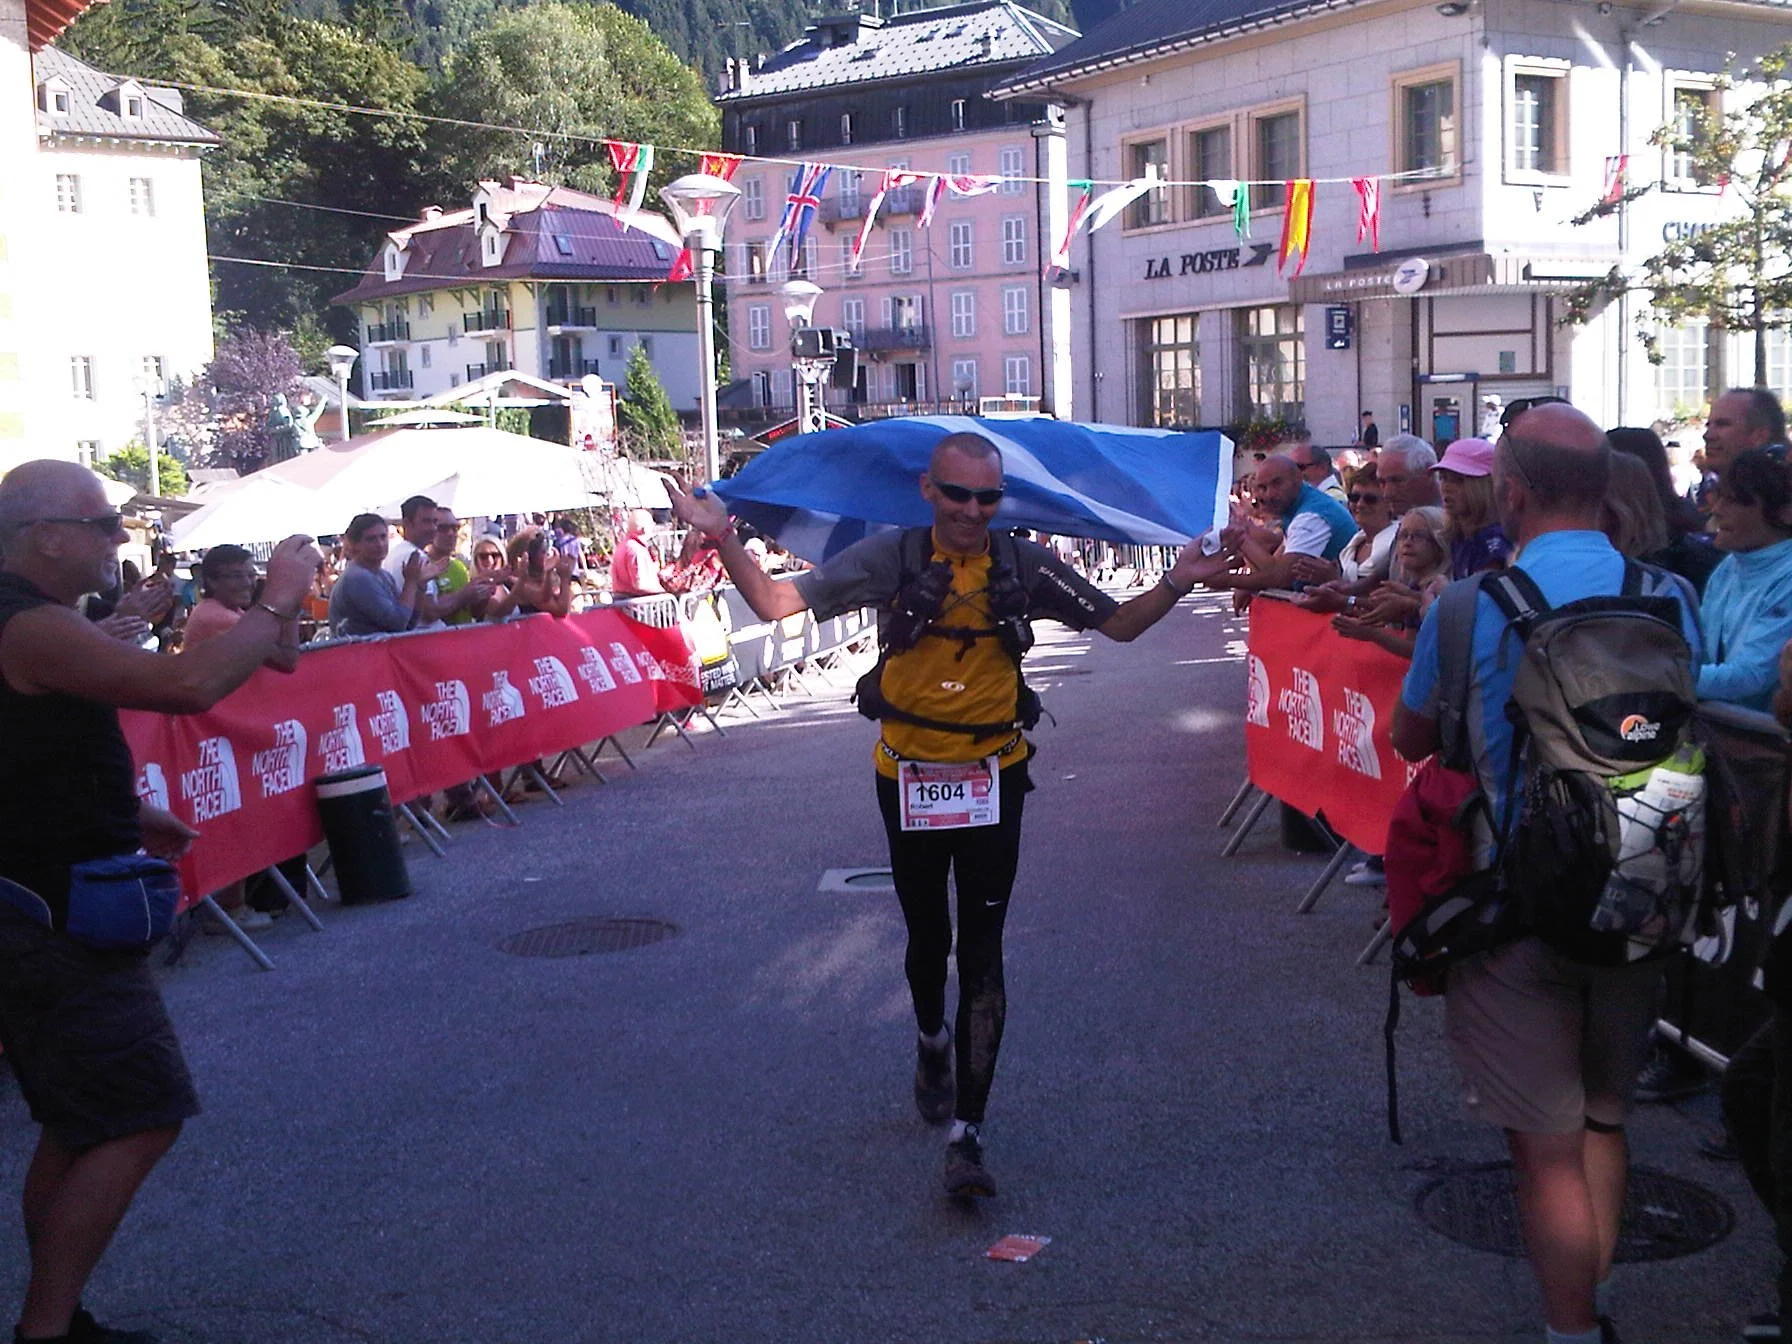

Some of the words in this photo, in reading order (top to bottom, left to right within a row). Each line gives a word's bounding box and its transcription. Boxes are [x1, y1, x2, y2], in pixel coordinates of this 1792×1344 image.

[1144, 257, 1173, 280] LA
[1179, 247, 1240, 276] POSTE
[1326, 281, 1343, 290] LA
[1349, 275, 1392, 288] POSTE
[533, 657, 553, 677] THE
[435, 681, 456, 702] THE
[528, 673, 557, 697] NORTH
[1292, 667, 1310, 697] THE
[376, 690, 394, 714] THE
[421, 699, 456, 725] NORTH
[542, 688, 564, 711] FACE
[1278, 687, 1308, 723] NORTH
[1343, 686, 1363, 721] THE
[333, 704, 351, 729] THE
[431, 718, 457, 741] FACE
[1287, 712, 1311, 747] FACE
[1333, 708, 1360, 748] NORTH
[273, 720, 296, 748] THE
[198, 738, 220, 769] THE
[252, 745, 290, 777] NORTH
[324, 748, 350, 775] FACE
[1338, 738, 1363, 775] FACE
[181, 764, 222, 801] NORTH
[262, 767, 290, 799] FACE
[915, 783, 966, 803] 1604
[193, 791, 222, 825] FACE
